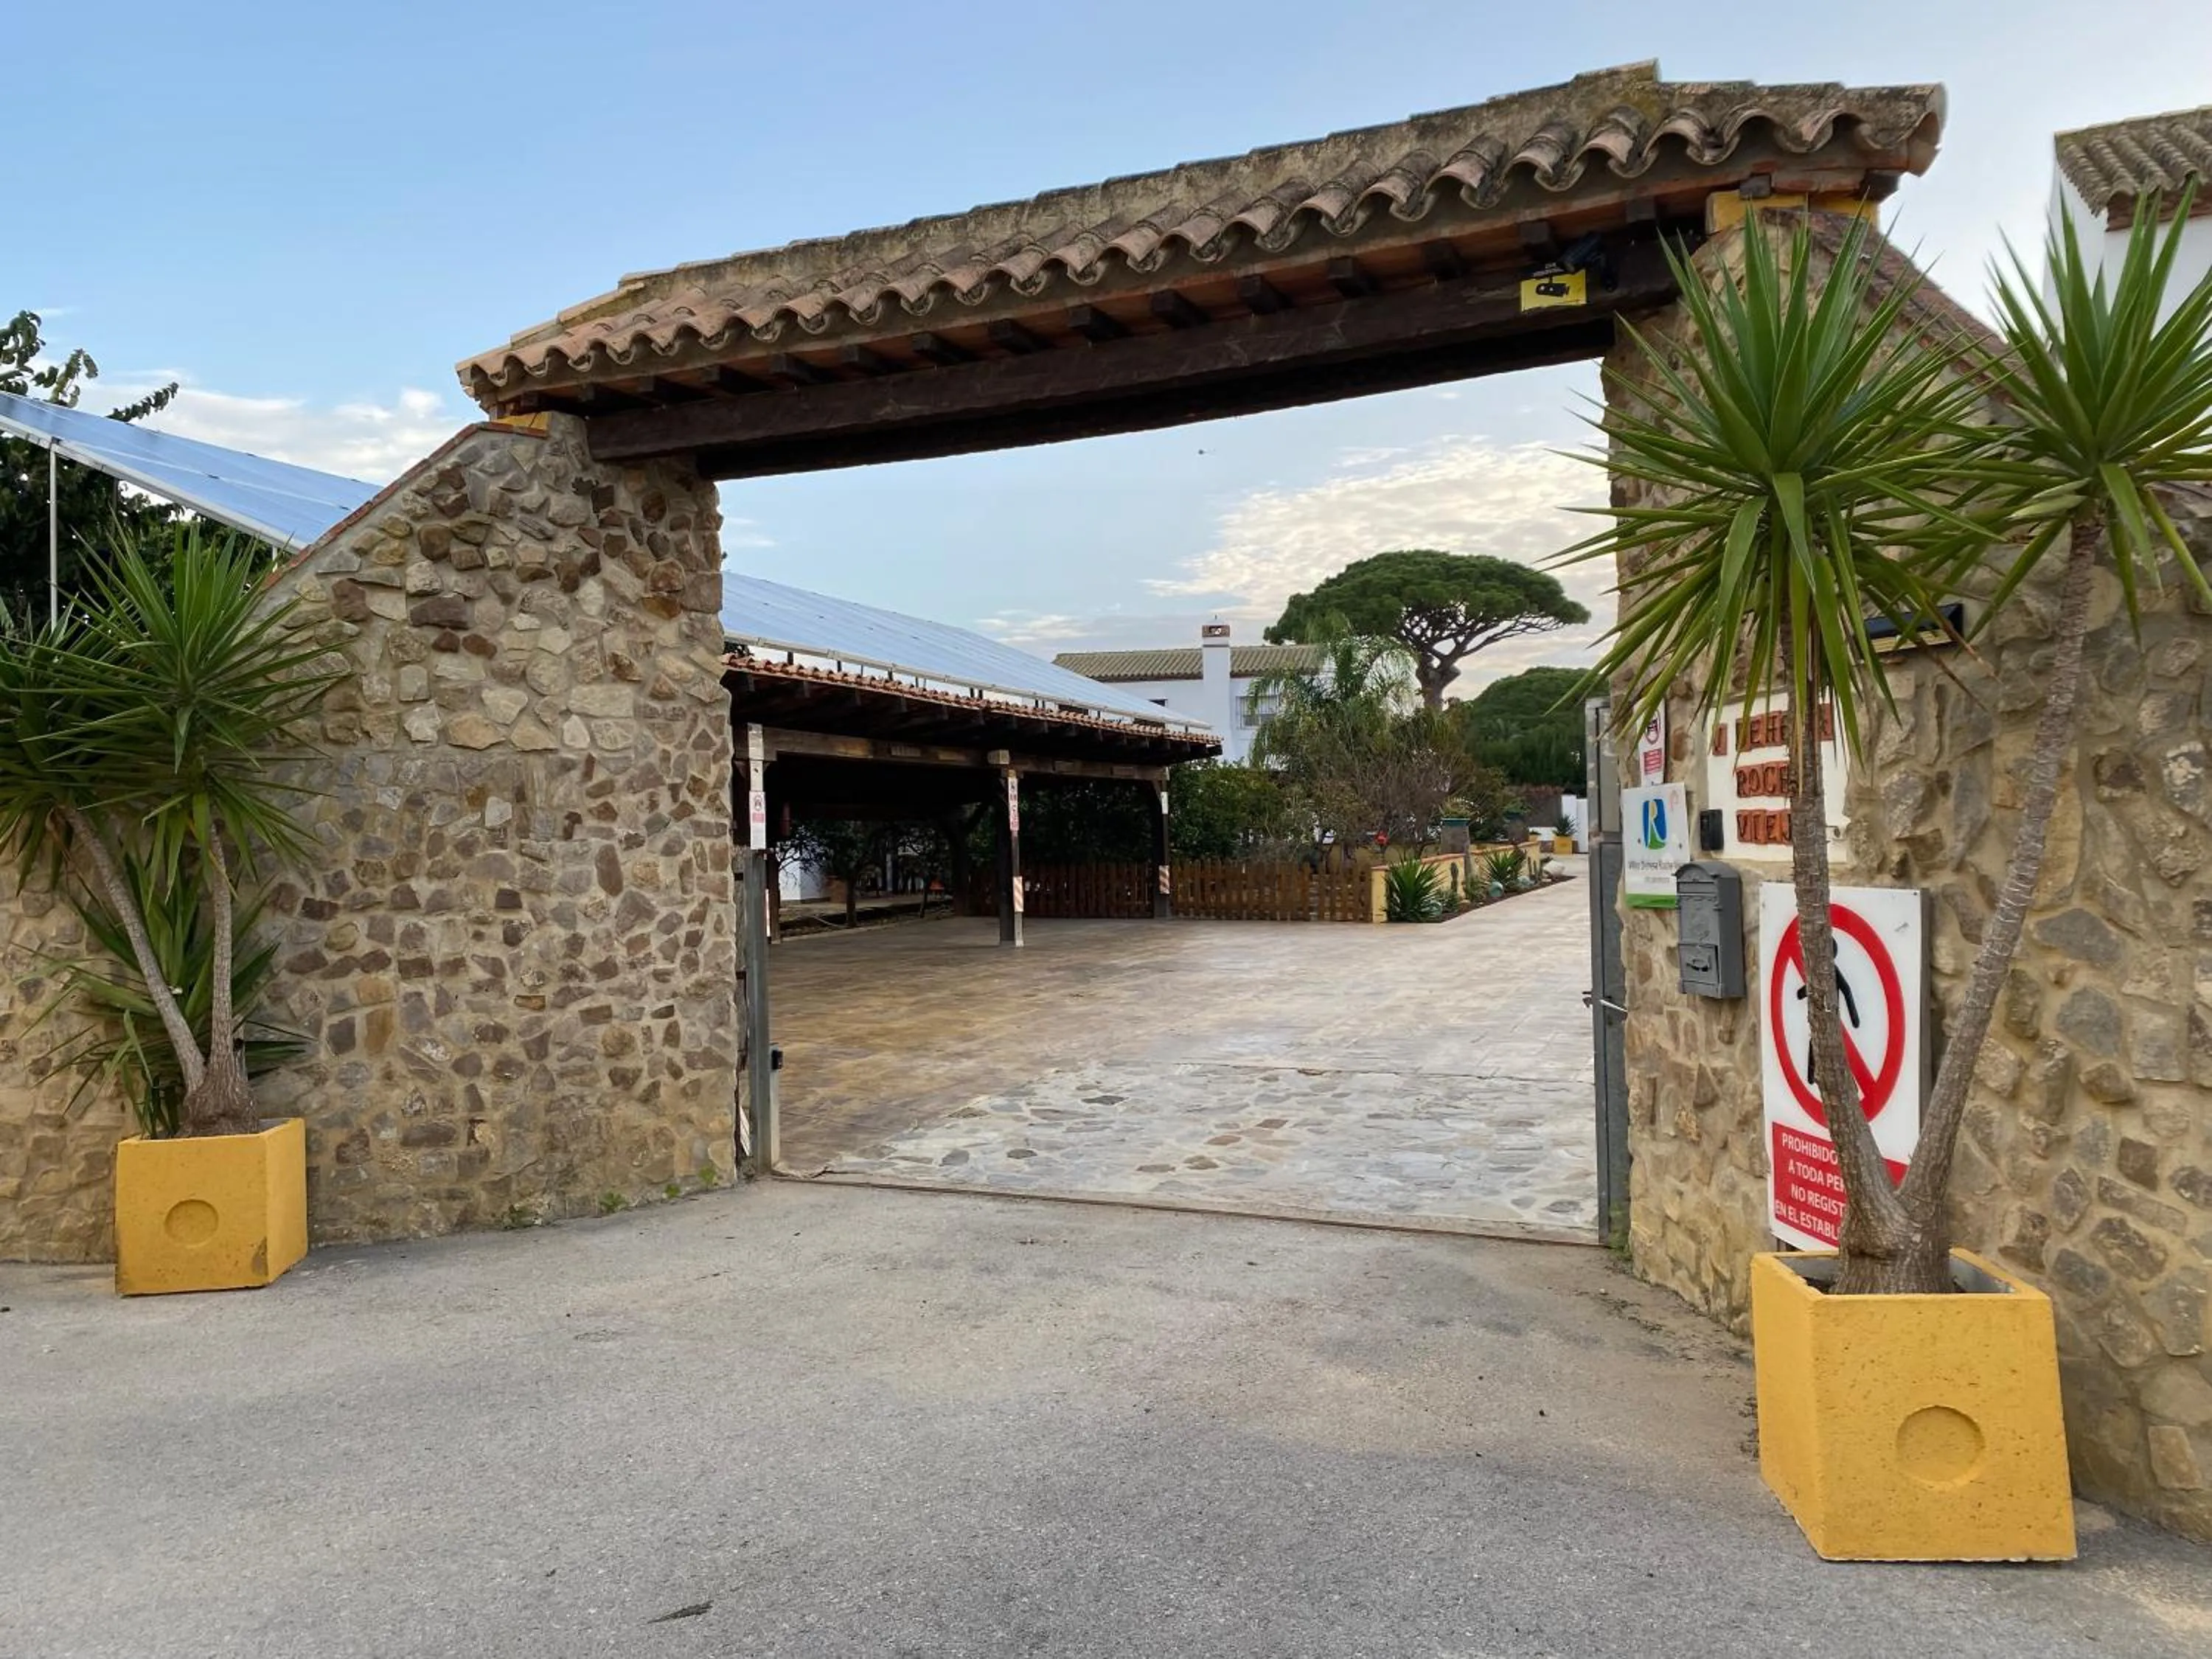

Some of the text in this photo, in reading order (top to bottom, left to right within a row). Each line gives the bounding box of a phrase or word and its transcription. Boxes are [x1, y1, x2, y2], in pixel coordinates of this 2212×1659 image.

[1736, 765, 1790, 796] ROCH
[1736, 813, 1792, 842] VIEJ
[1781, 1133, 1838, 1165] PROHIBIDO
[1788, 1158, 1795, 1175] A
[1795, 1161, 1825, 1186] TODA
[1790, 1183, 1846, 1217] NO REGIST
[1775, 1199, 1841, 1241] EN EL ESTABL
